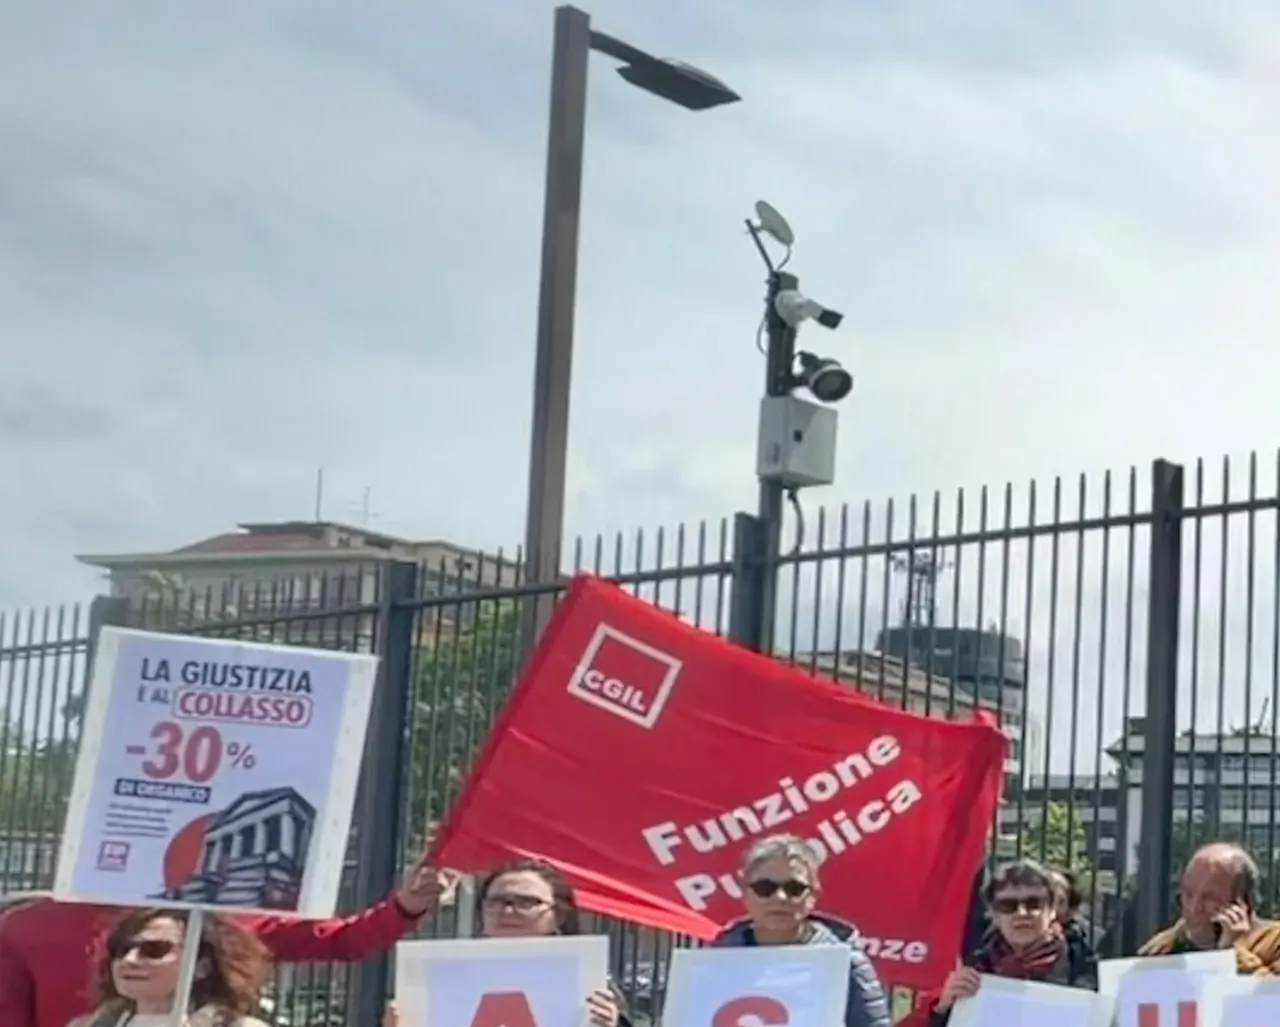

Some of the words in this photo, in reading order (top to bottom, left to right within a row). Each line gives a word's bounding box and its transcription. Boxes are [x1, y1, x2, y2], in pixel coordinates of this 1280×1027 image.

[141, 657, 170, 682] LA
[181, 661, 312, 693] GIUSTIZIA
[583, 669, 648, 713] CGIL
[179, 691, 305, 723] COLLASSO
[643, 733, 901, 866] Funzione
